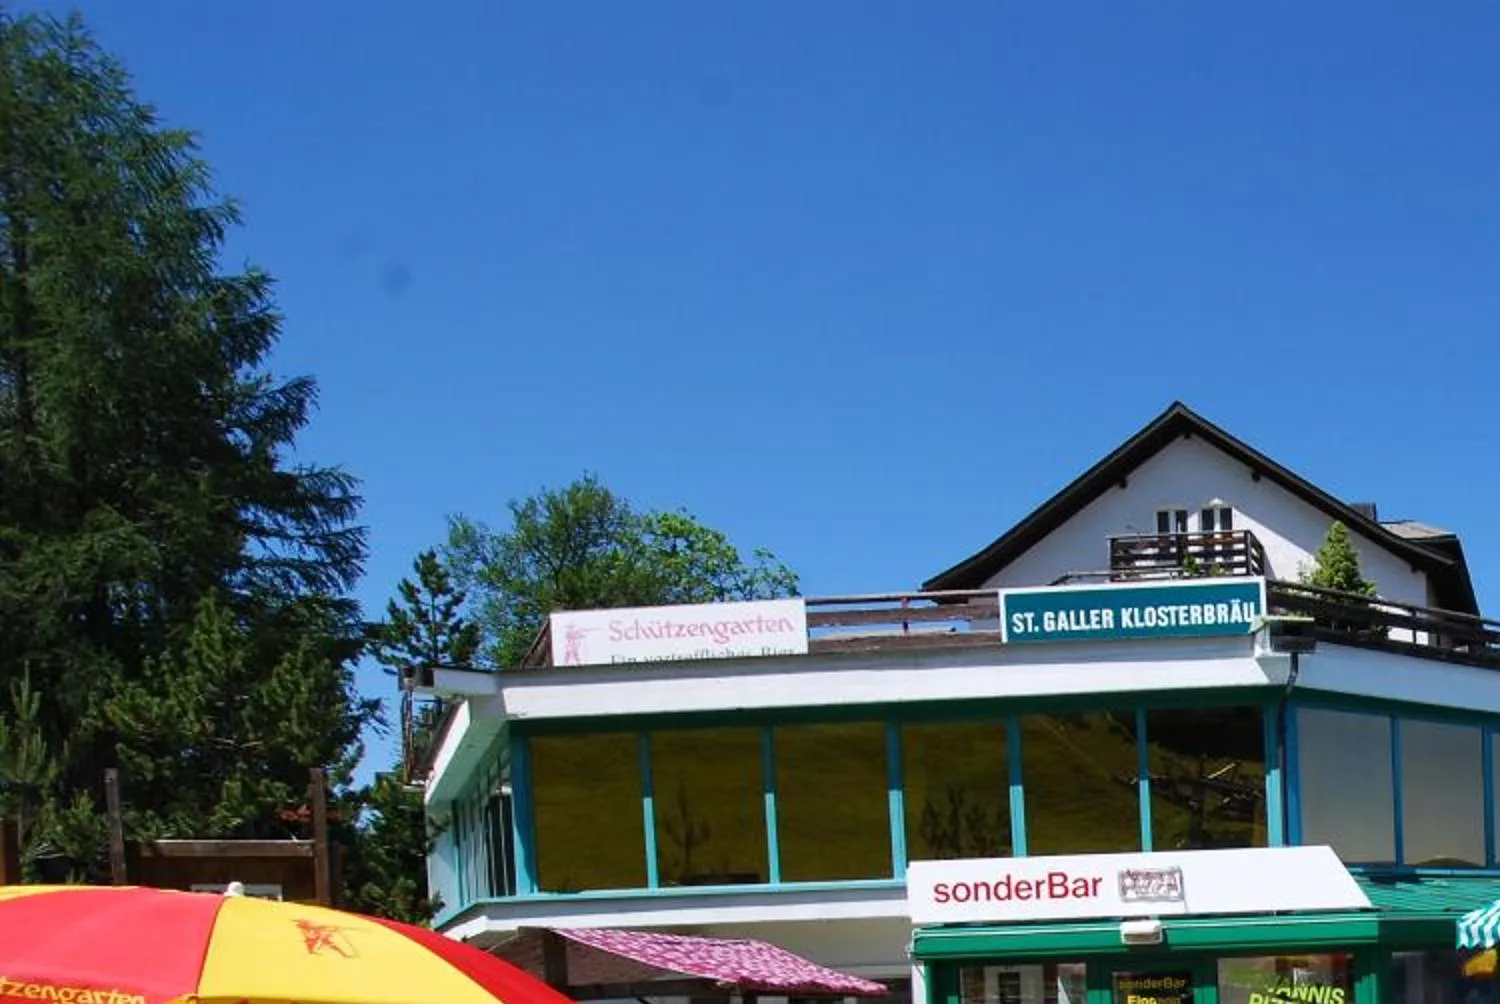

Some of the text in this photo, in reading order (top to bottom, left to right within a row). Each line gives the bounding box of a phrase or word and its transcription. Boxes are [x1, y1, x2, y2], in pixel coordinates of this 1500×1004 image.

[608, 614, 794, 645] Schützengarten
[1012, 599, 1255, 634] ST. GALLER KLOSTERBRÄU
[933, 871, 1103, 904] sonderBar
